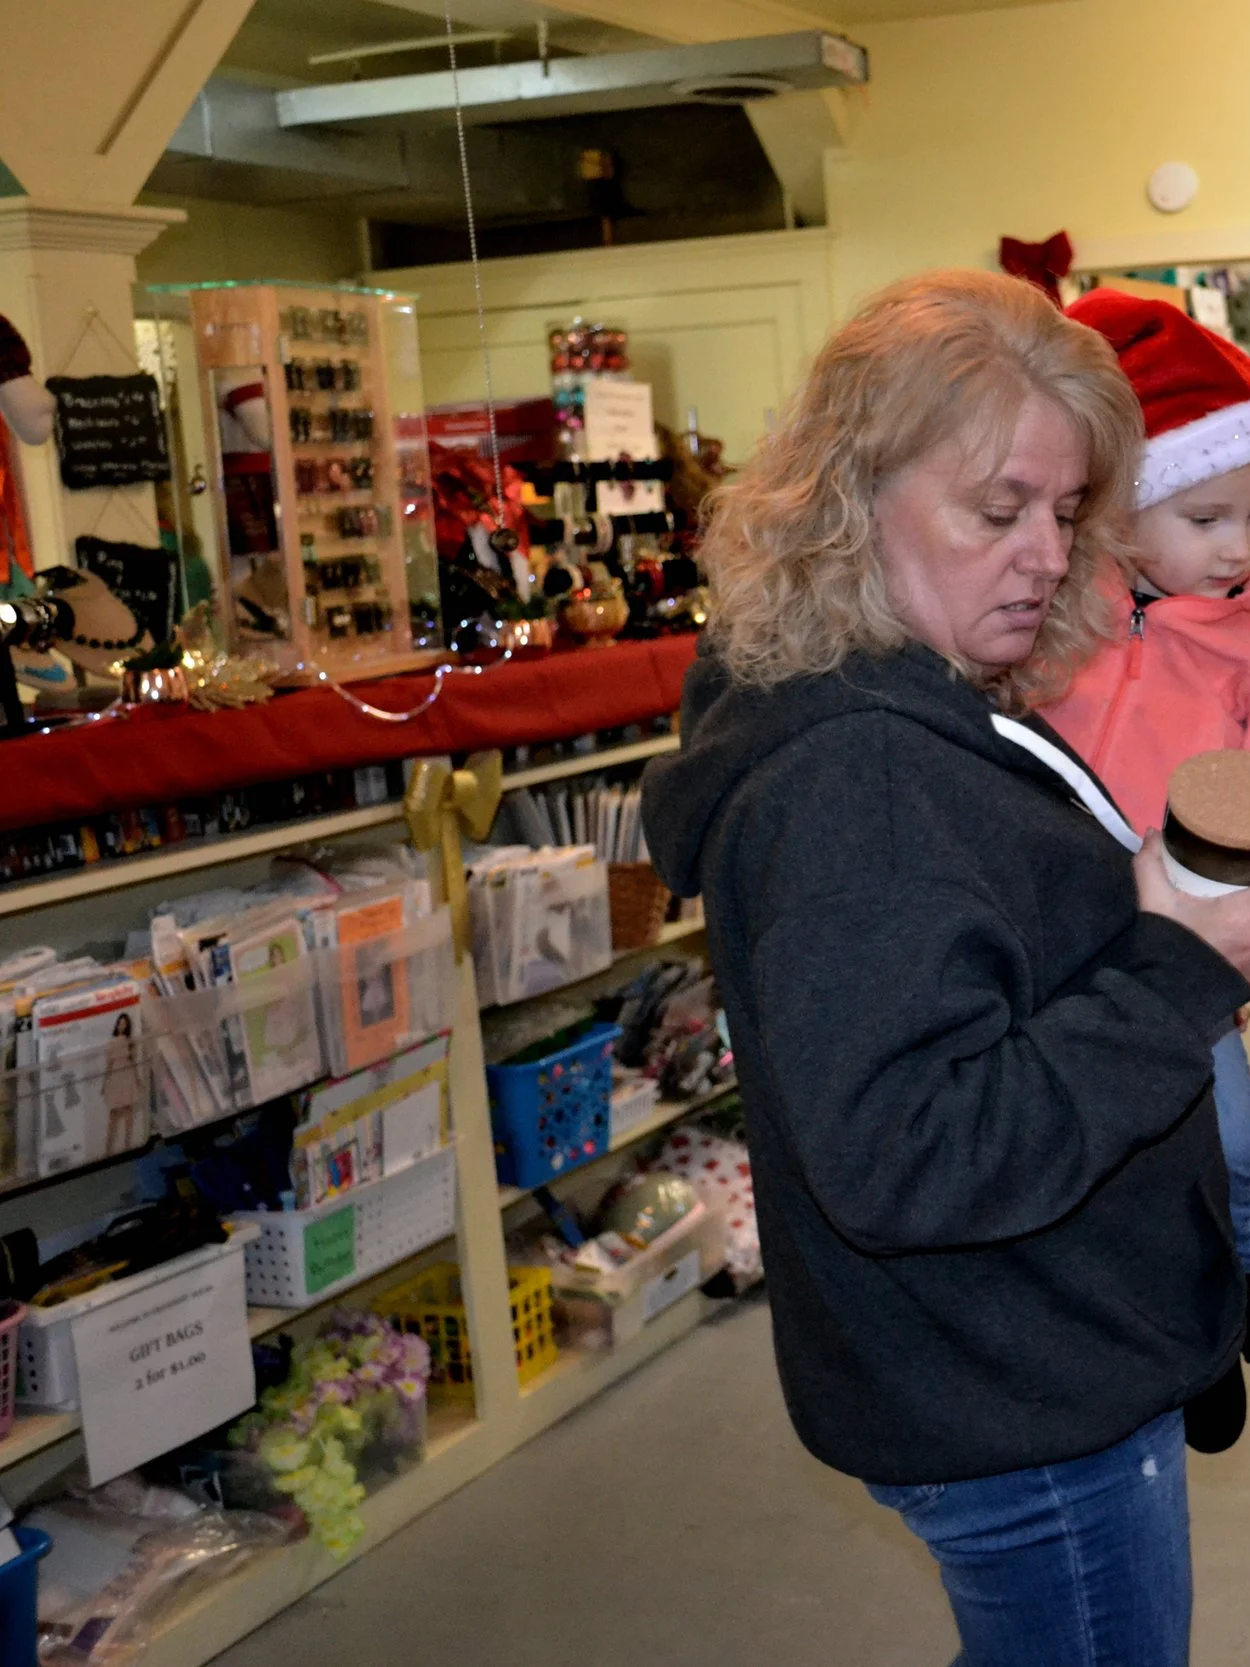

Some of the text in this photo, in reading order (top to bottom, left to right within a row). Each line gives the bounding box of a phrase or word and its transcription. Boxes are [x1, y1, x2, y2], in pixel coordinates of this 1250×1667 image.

[129, 1321, 204, 1363] GIFT BAGS
[135, 1351, 206, 1391] 2 for $1.00
